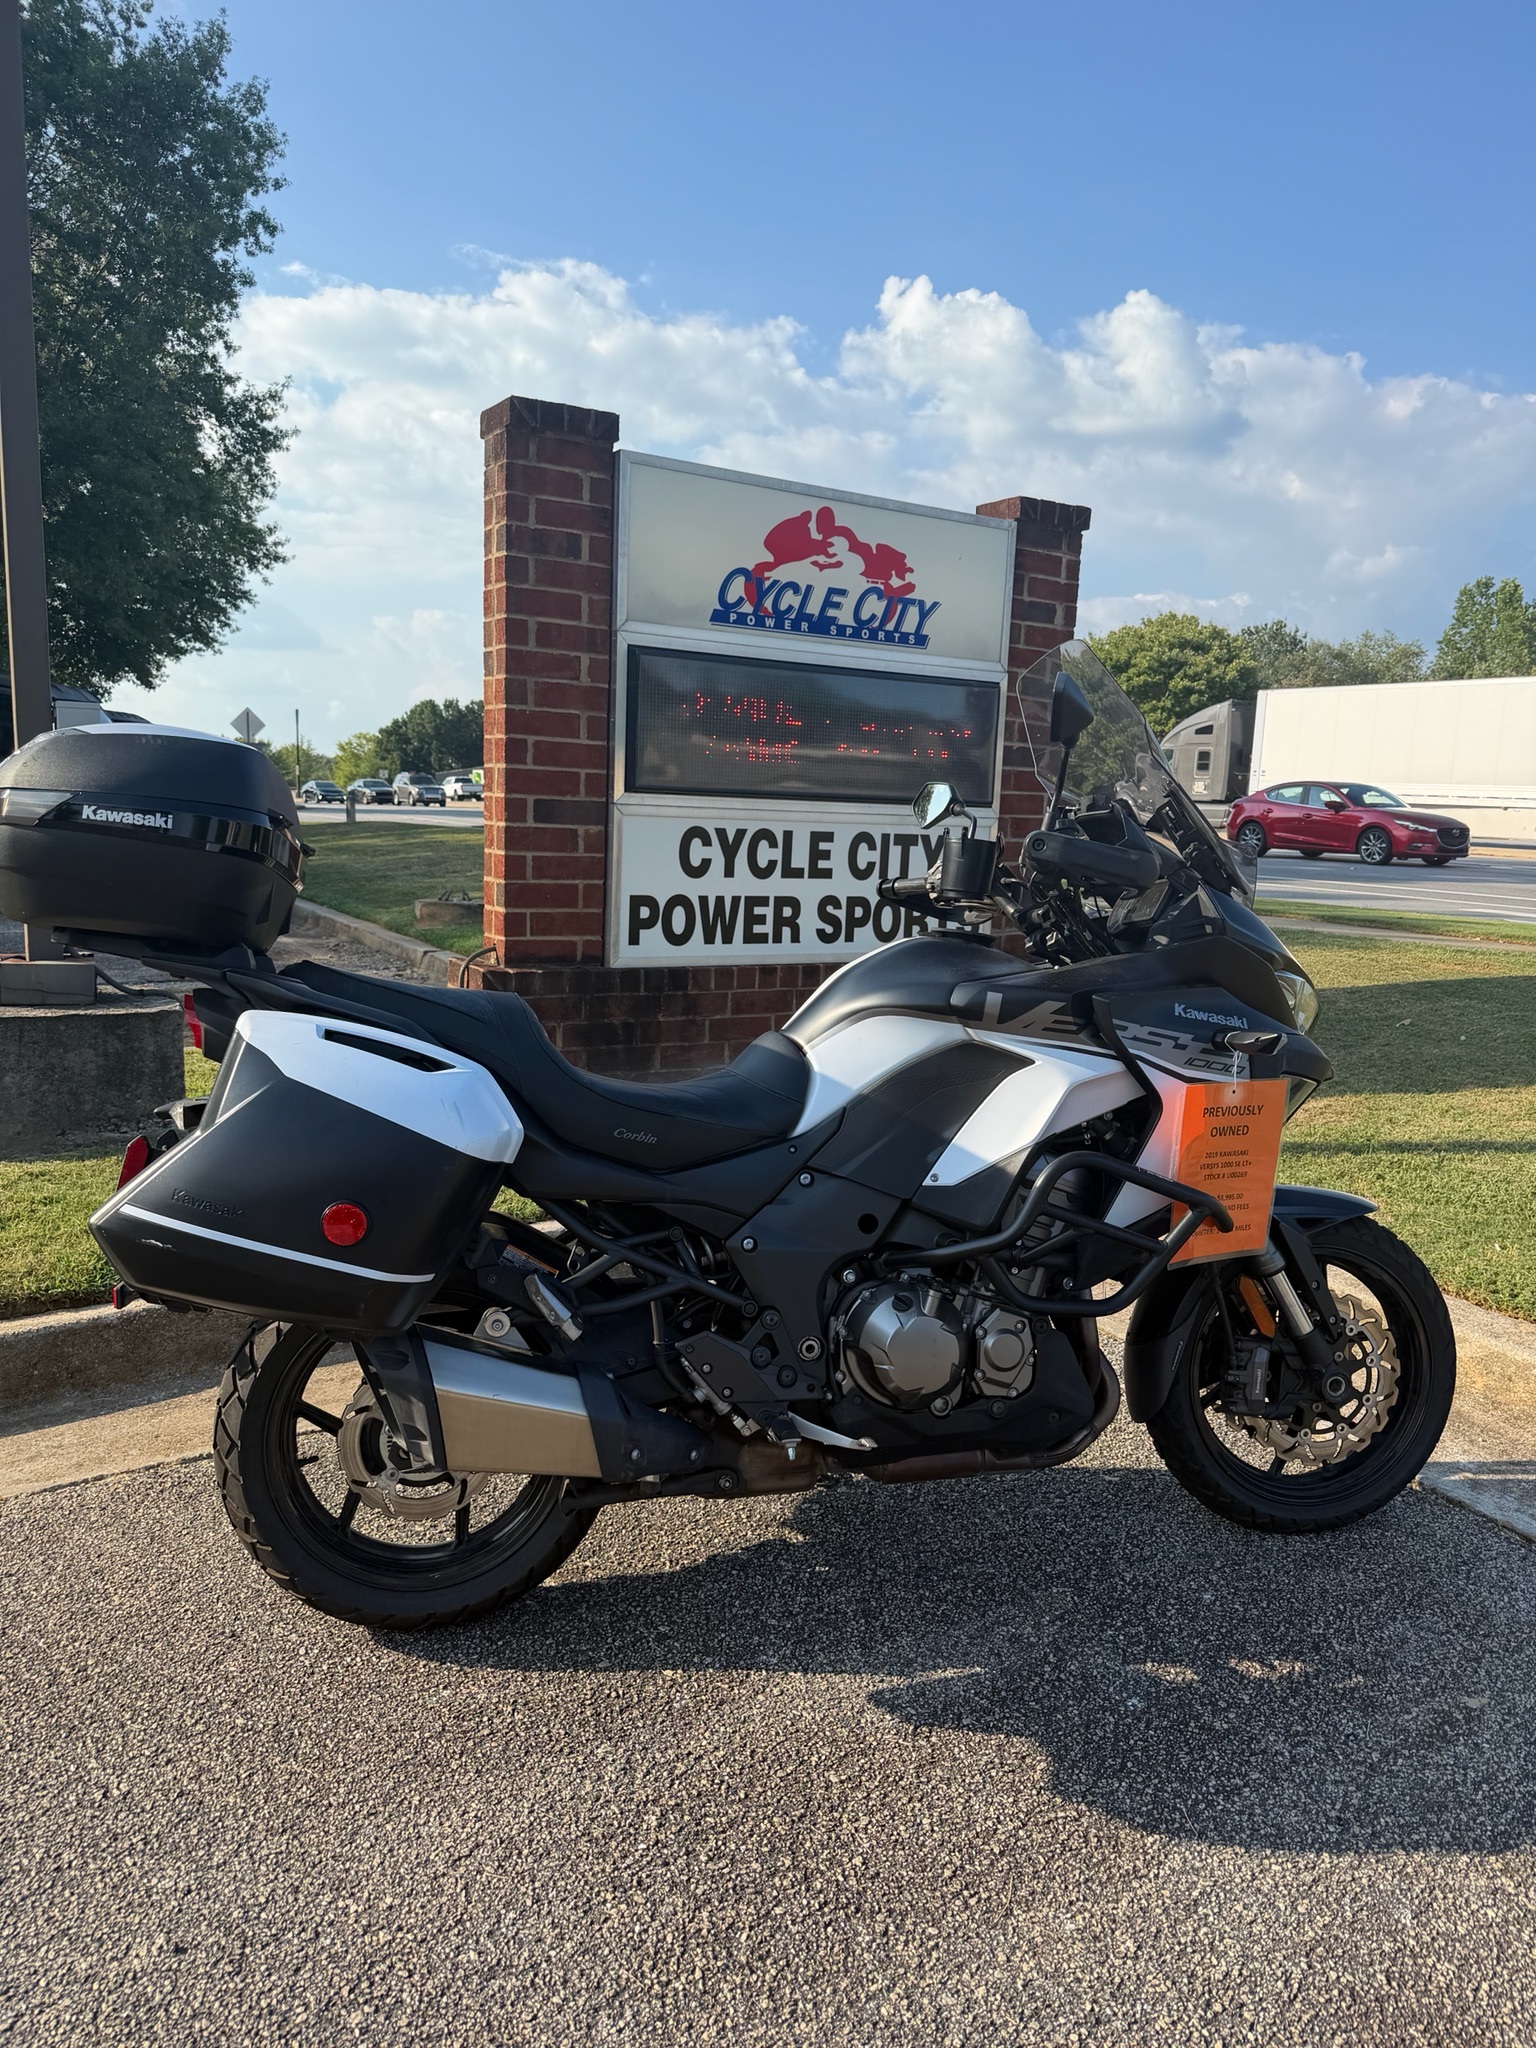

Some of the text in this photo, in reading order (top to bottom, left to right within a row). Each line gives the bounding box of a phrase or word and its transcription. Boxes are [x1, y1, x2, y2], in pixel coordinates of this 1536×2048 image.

[718, 567, 942, 634] CYCLE CITY
[729, 612, 915, 645] POWER SPORTS
[82, 804, 173, 829] Kawasaki
[678, 825, 944, 881] CYCLE CITY
[628, 893, 981, 947] POWER SPOR
[1174, 1003, 1249, 1029] Kawasaki
[1184, 1057, 1247, 1075] 1000
[1202, 1104, 1265, 1118] PREVIOUSLY
[613, 1128, 658, 1144] Corbin
[1210, 1125, 1250, 1138] OWNED
[1205, 1149, 1249, 1159] 2019 KAWASAKI
[1199, 1161, 1219, 1171] VERSYS
[1220, 1160, 1234, 1169] 1000
[1234, 1160, 1241, 1168] SE
[1203, 1172, 1221, 1181] STOCK
[1236, 1203, 1250, 1211] FEES
[1235, 1223, 1252, 1232] MILES
